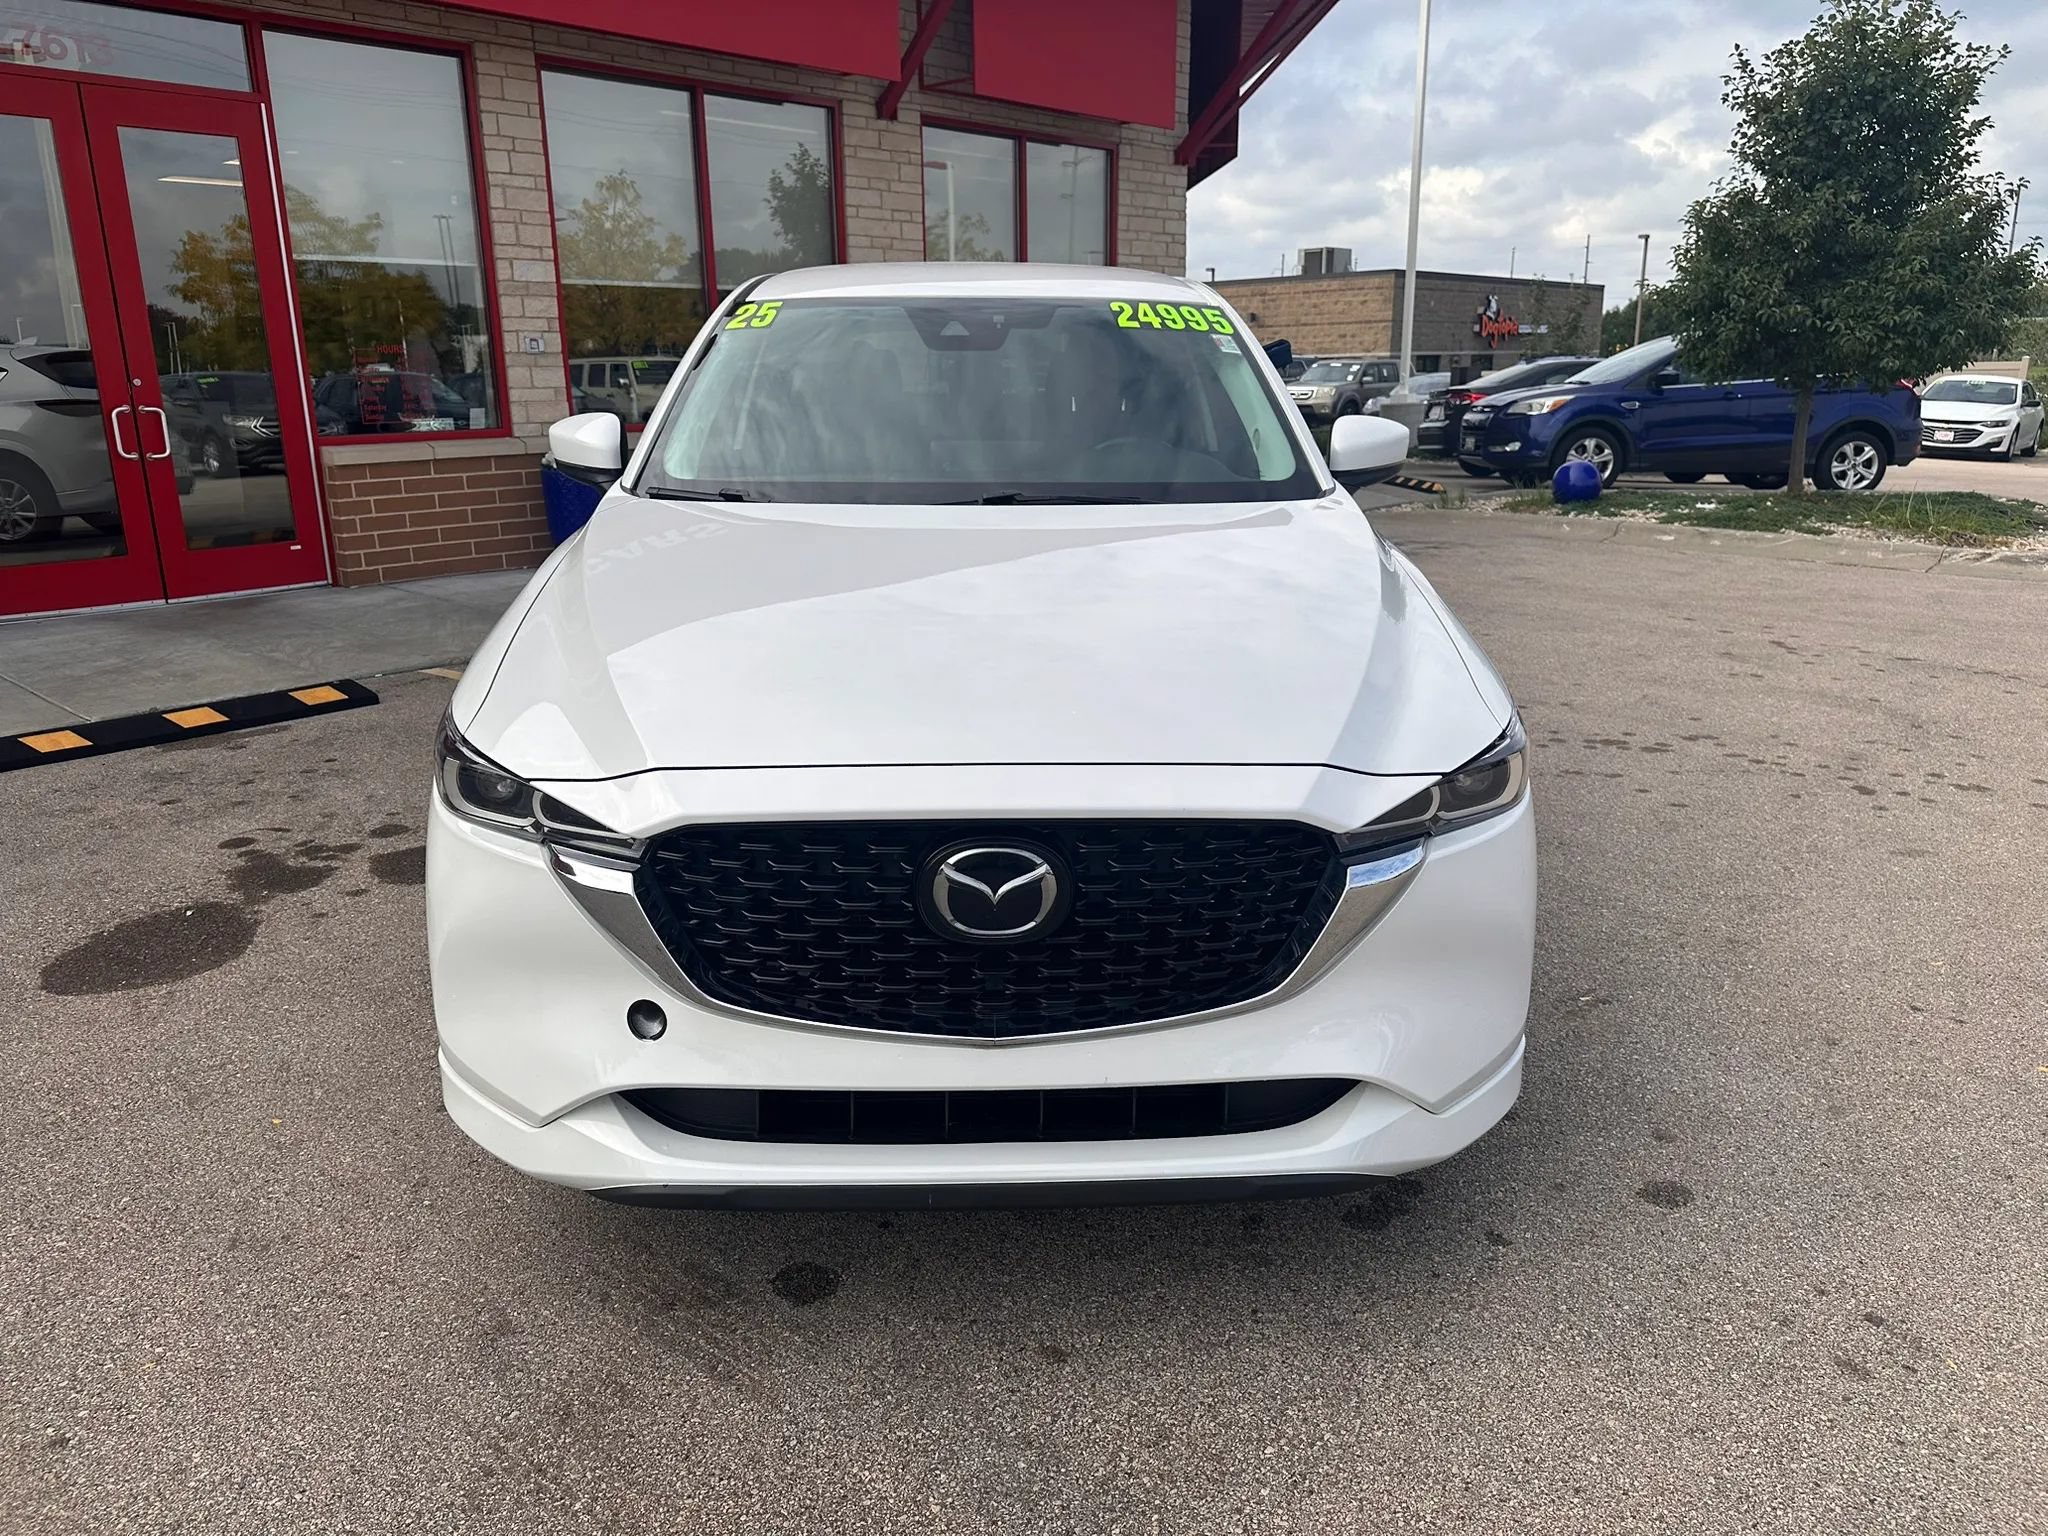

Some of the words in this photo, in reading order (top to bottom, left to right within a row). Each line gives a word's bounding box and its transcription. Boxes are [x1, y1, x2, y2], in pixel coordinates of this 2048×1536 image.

[724, 301, 784, 330] 25
[1109, 301, 1234, 335] 24995
[377, 343, 405, 354] HOURS
